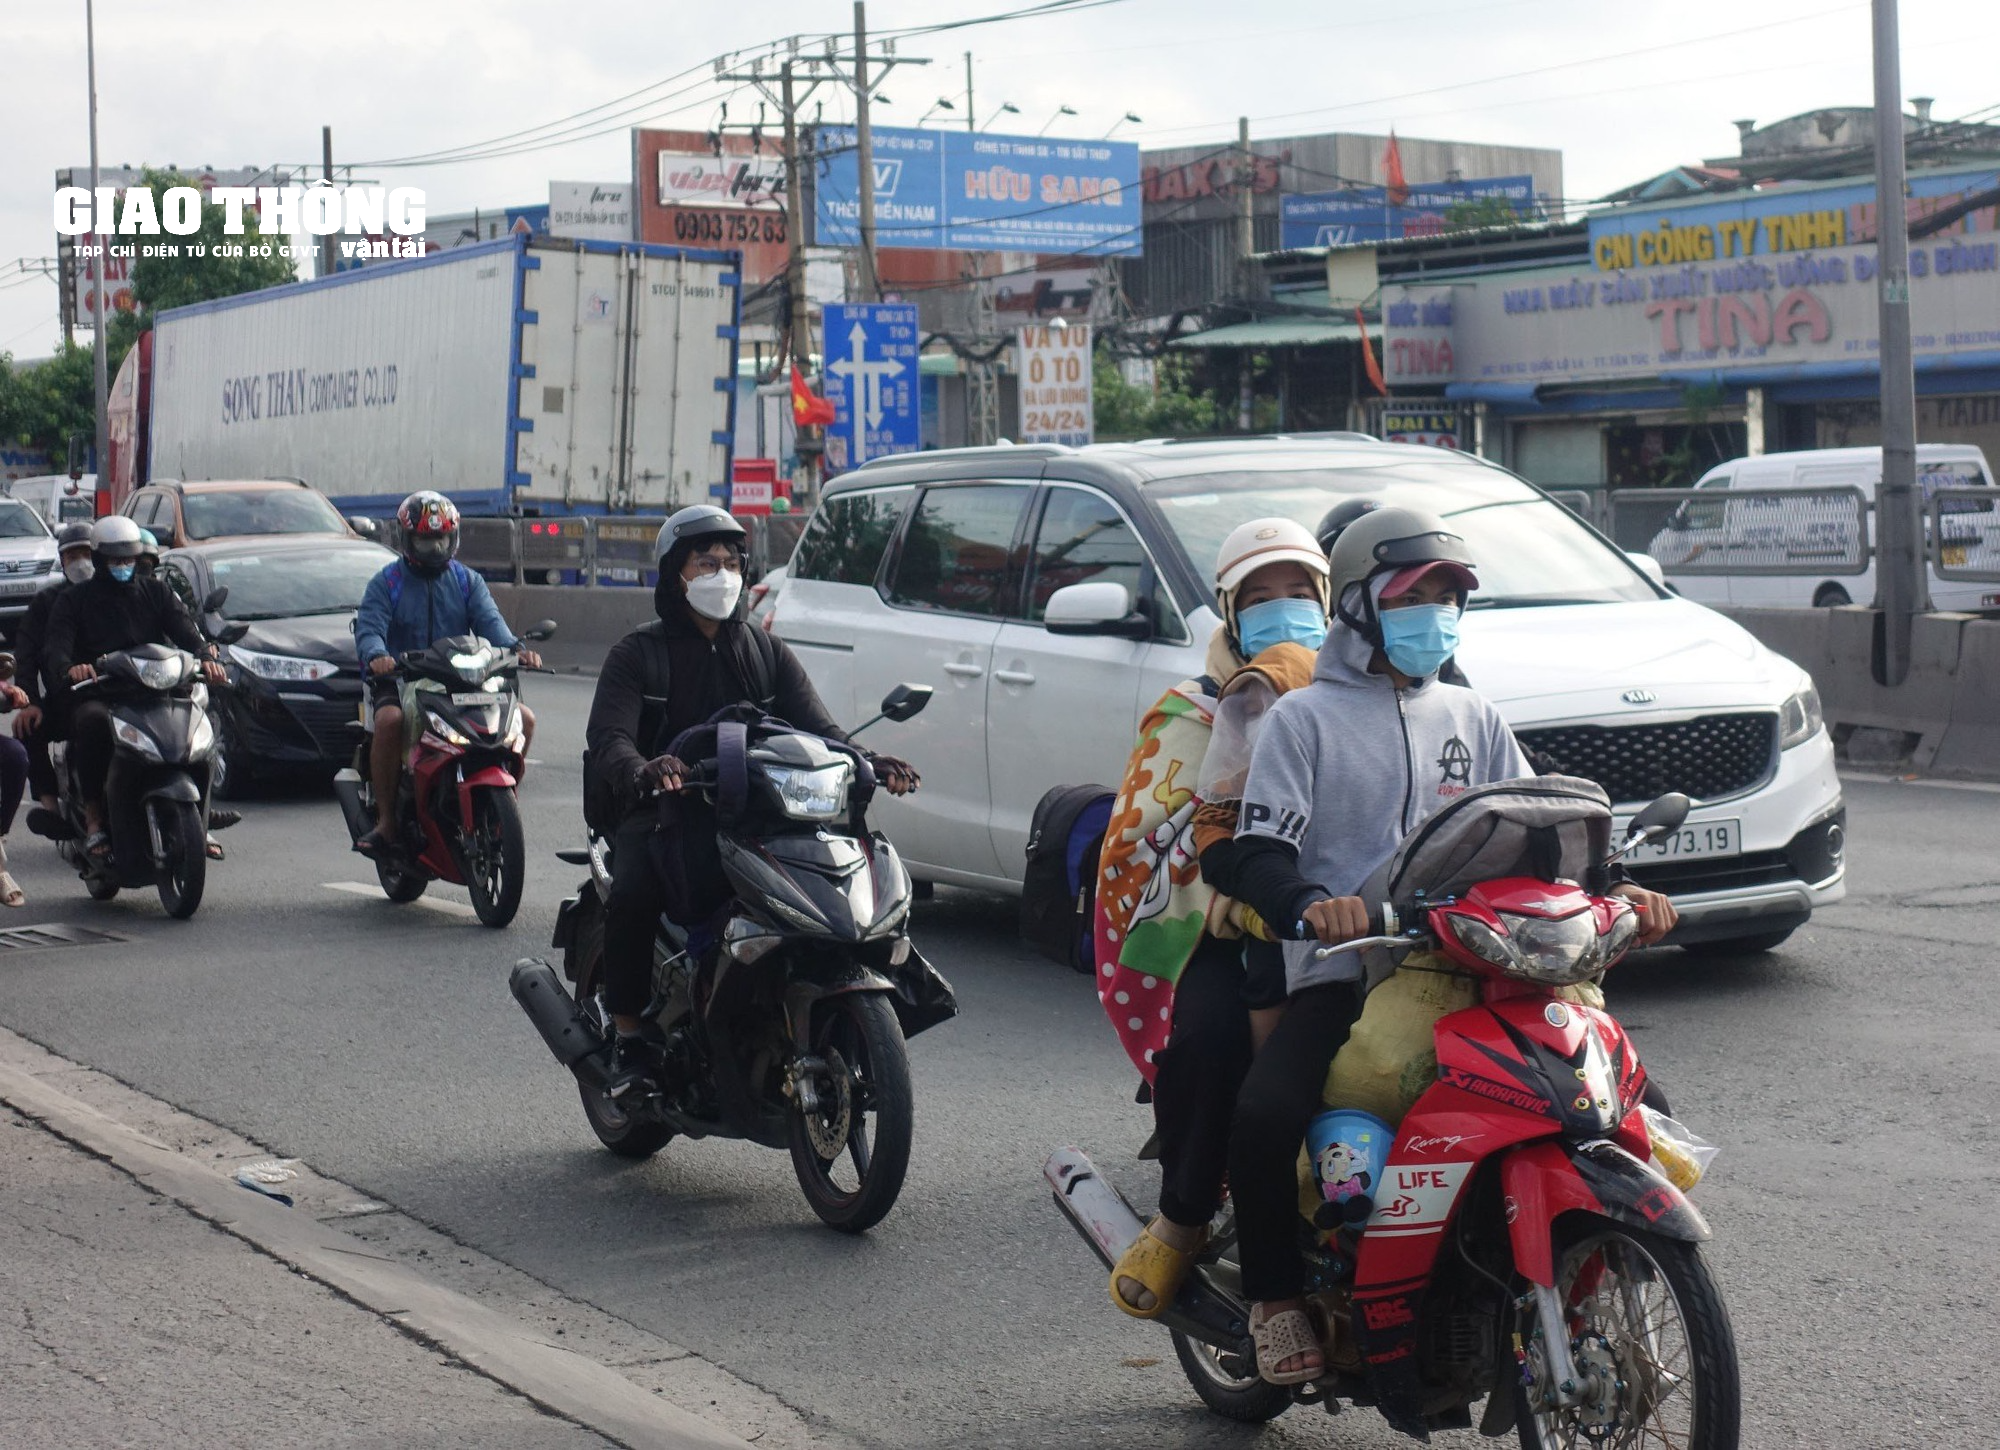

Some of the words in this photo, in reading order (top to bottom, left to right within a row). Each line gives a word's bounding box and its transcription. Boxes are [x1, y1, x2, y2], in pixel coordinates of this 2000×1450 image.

[1040, 174, 1123, 207] SANG
[1595, 233, 1634, 271] CN
[1637, 218, 1715, 267] CÔNG
[1717, 217, 1758, 258] TY
[1761, 208, 1846, 254] TNHH
[1854, 247, 1928, 281] ĐG
[1644, 286, 1832, 355] TINA
[1029, 351, 1045, 384] Ô
[1052, 350, 1081, 383] TÔ
[222, 374, 262, 425] SONG
[266, 368, 306, 419] THAN
[309, 368, 359, 413] CONTAINER
[1025, 409, 1086, 432] 24/24
[1398, 1170, 1450, 1190] LIFE
